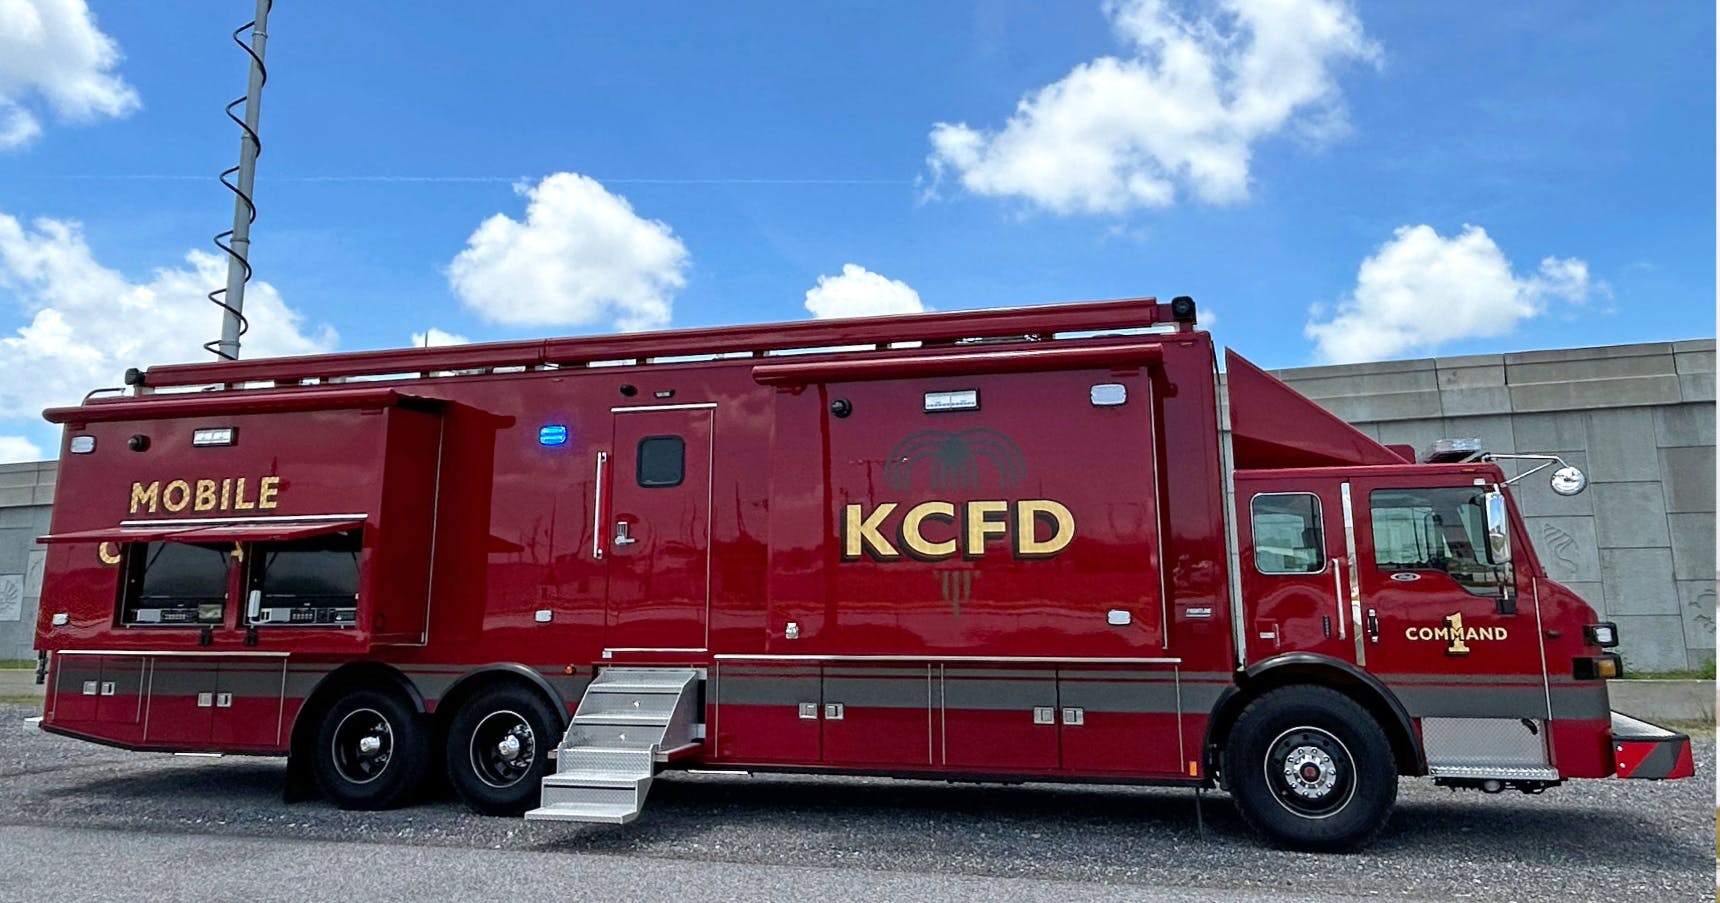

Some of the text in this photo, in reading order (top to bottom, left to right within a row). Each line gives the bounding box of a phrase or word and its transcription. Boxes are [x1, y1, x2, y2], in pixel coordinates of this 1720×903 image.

[130, 476, 280, 514] MOBILE
[842, 499, 1076, 558] KCFD
[1405, 626, 1508, 641] COMMAND
[1446, 611, 1470, 653] 1
